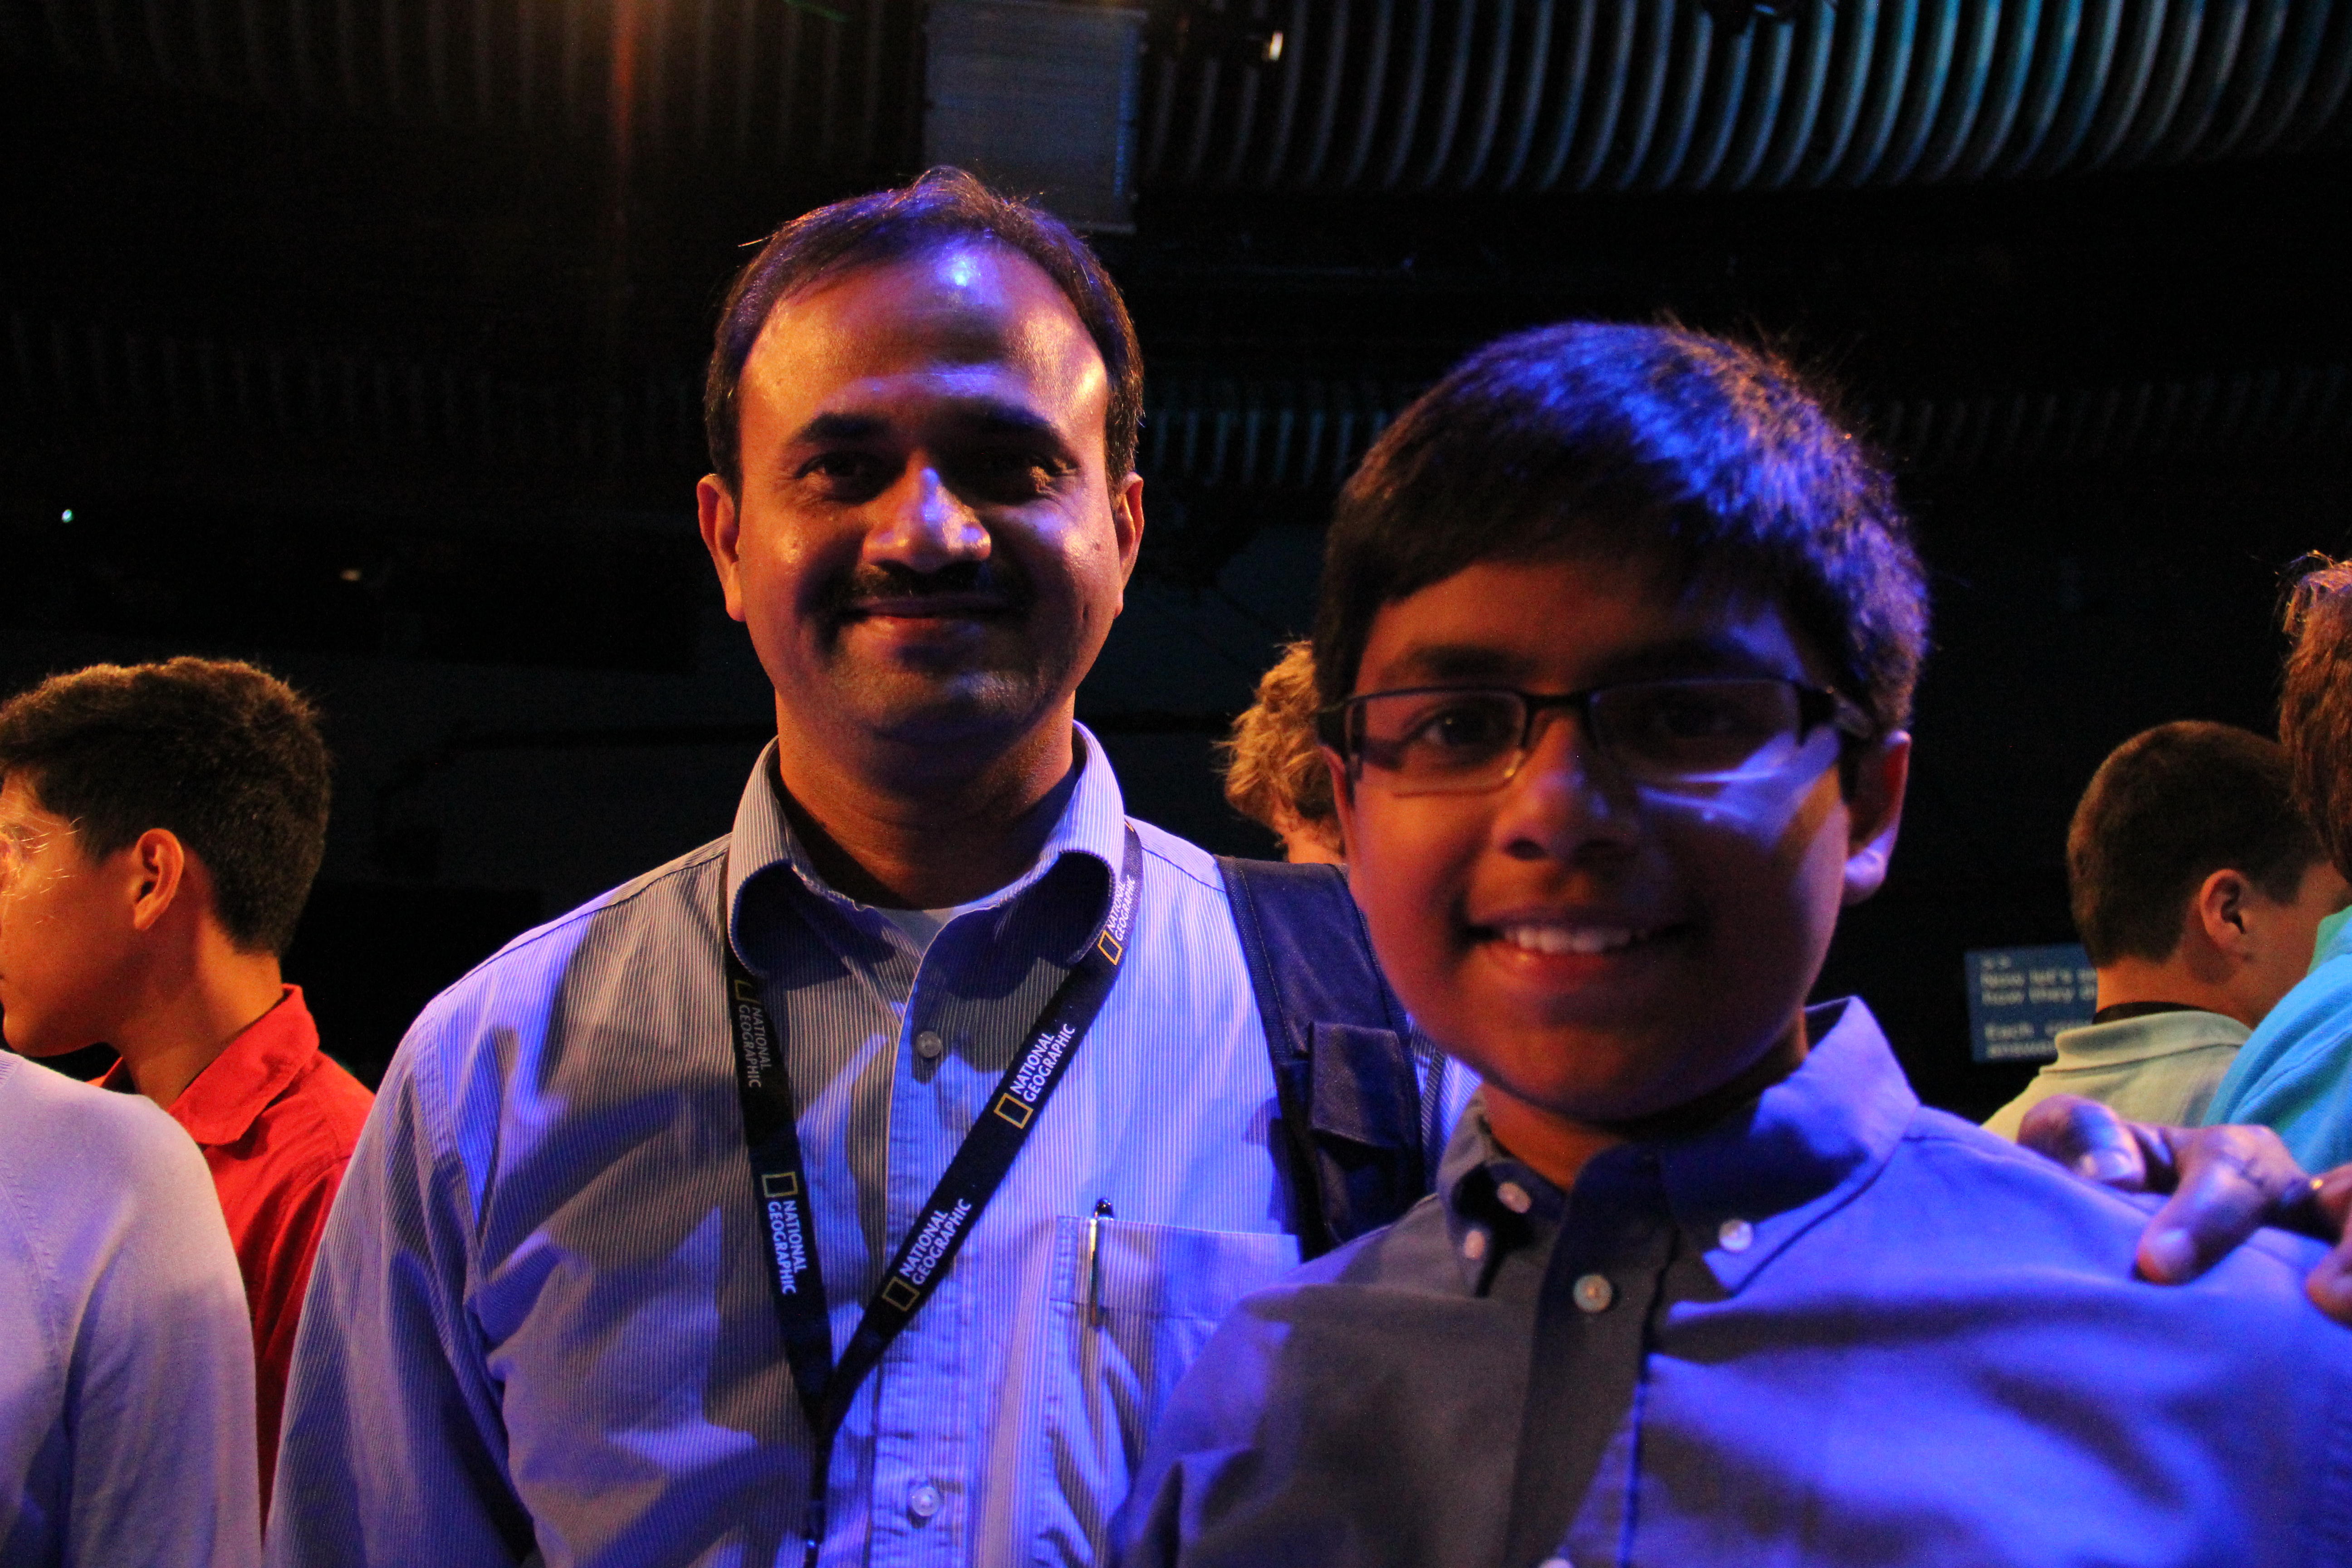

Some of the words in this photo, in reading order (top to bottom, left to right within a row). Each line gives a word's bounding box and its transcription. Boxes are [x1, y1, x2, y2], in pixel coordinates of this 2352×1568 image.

[1107, 881, 1125, 933] NATIONAL
[1114, 874, 1135, 941] GEOGRAPHIC
[739, 1004, 761, 1088] GEOGRAPHIC
[752, 1007, 772, 1070] NATIONAL
[1009, 1033, 1055, 1095] NATIONAL
[1023, 1023, 1076, 1102] GEOGRAPHIC
[768, 1201, 797, 1294] GEOGRAPHIC
[783, 1200, 808, 1274] NATIONAL
[899, 1210, 948, 1277] NATIONAL
[911, 1198, 971, 1285] GEOGRAPHIC
